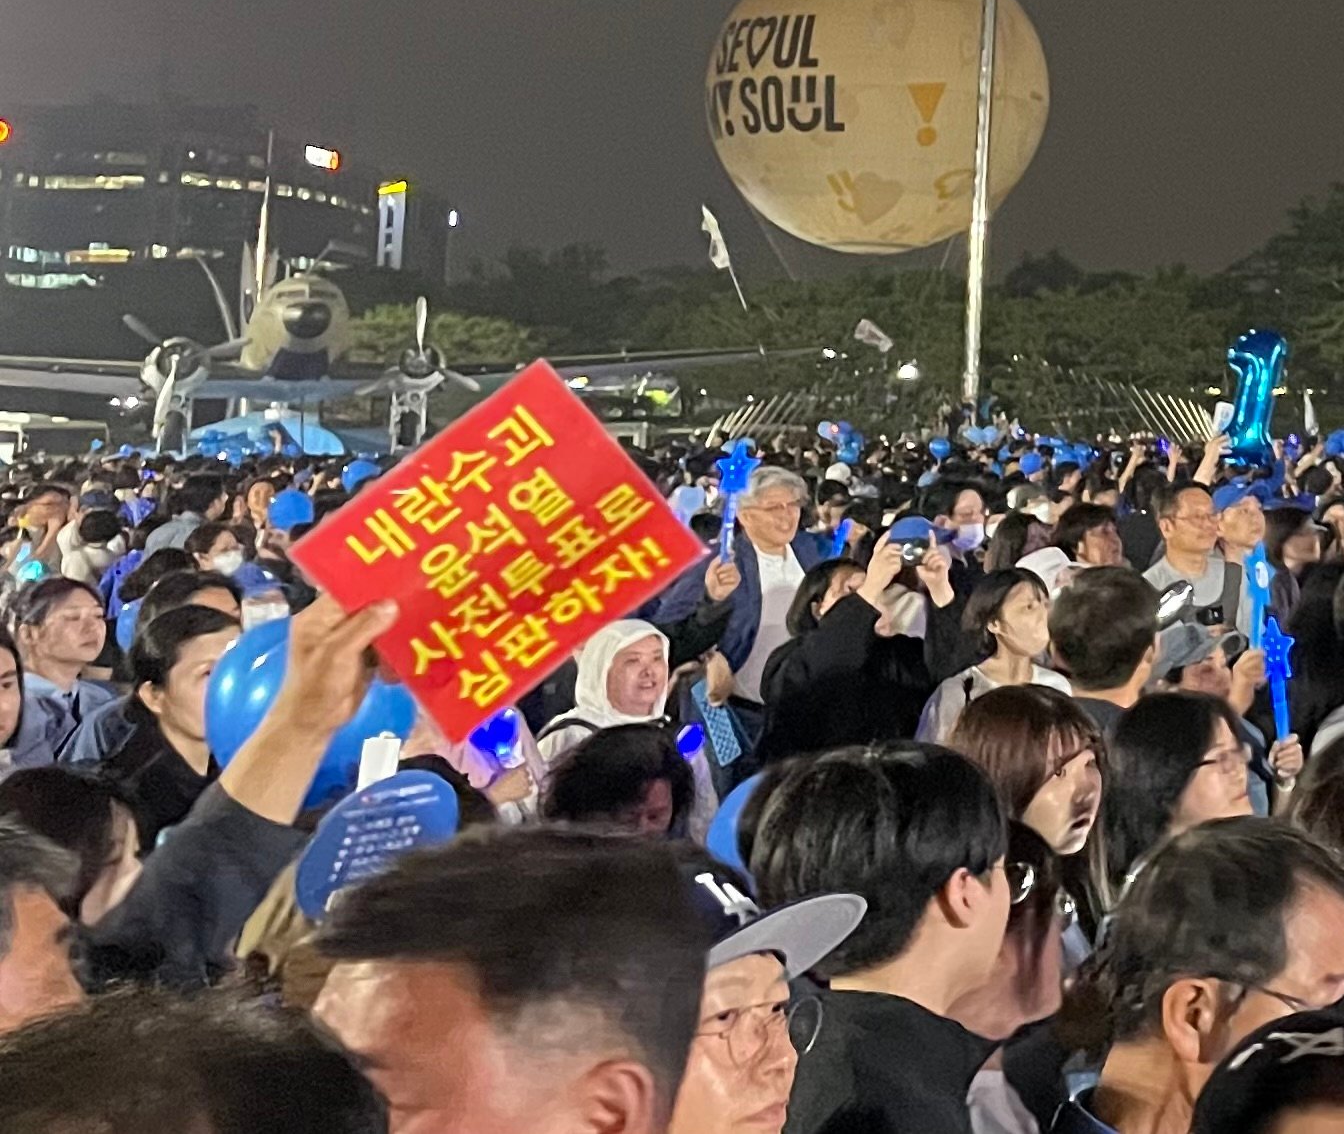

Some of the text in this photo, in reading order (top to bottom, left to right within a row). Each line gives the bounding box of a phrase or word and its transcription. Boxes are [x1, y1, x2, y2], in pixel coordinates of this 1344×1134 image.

[345, 405, 555, 565] 내란수괴
[420, 467, 575, 599] 윤석열
[409, 483, 654, 675] 사전투표로
[458, 537, 672, 708] 심판하자!
